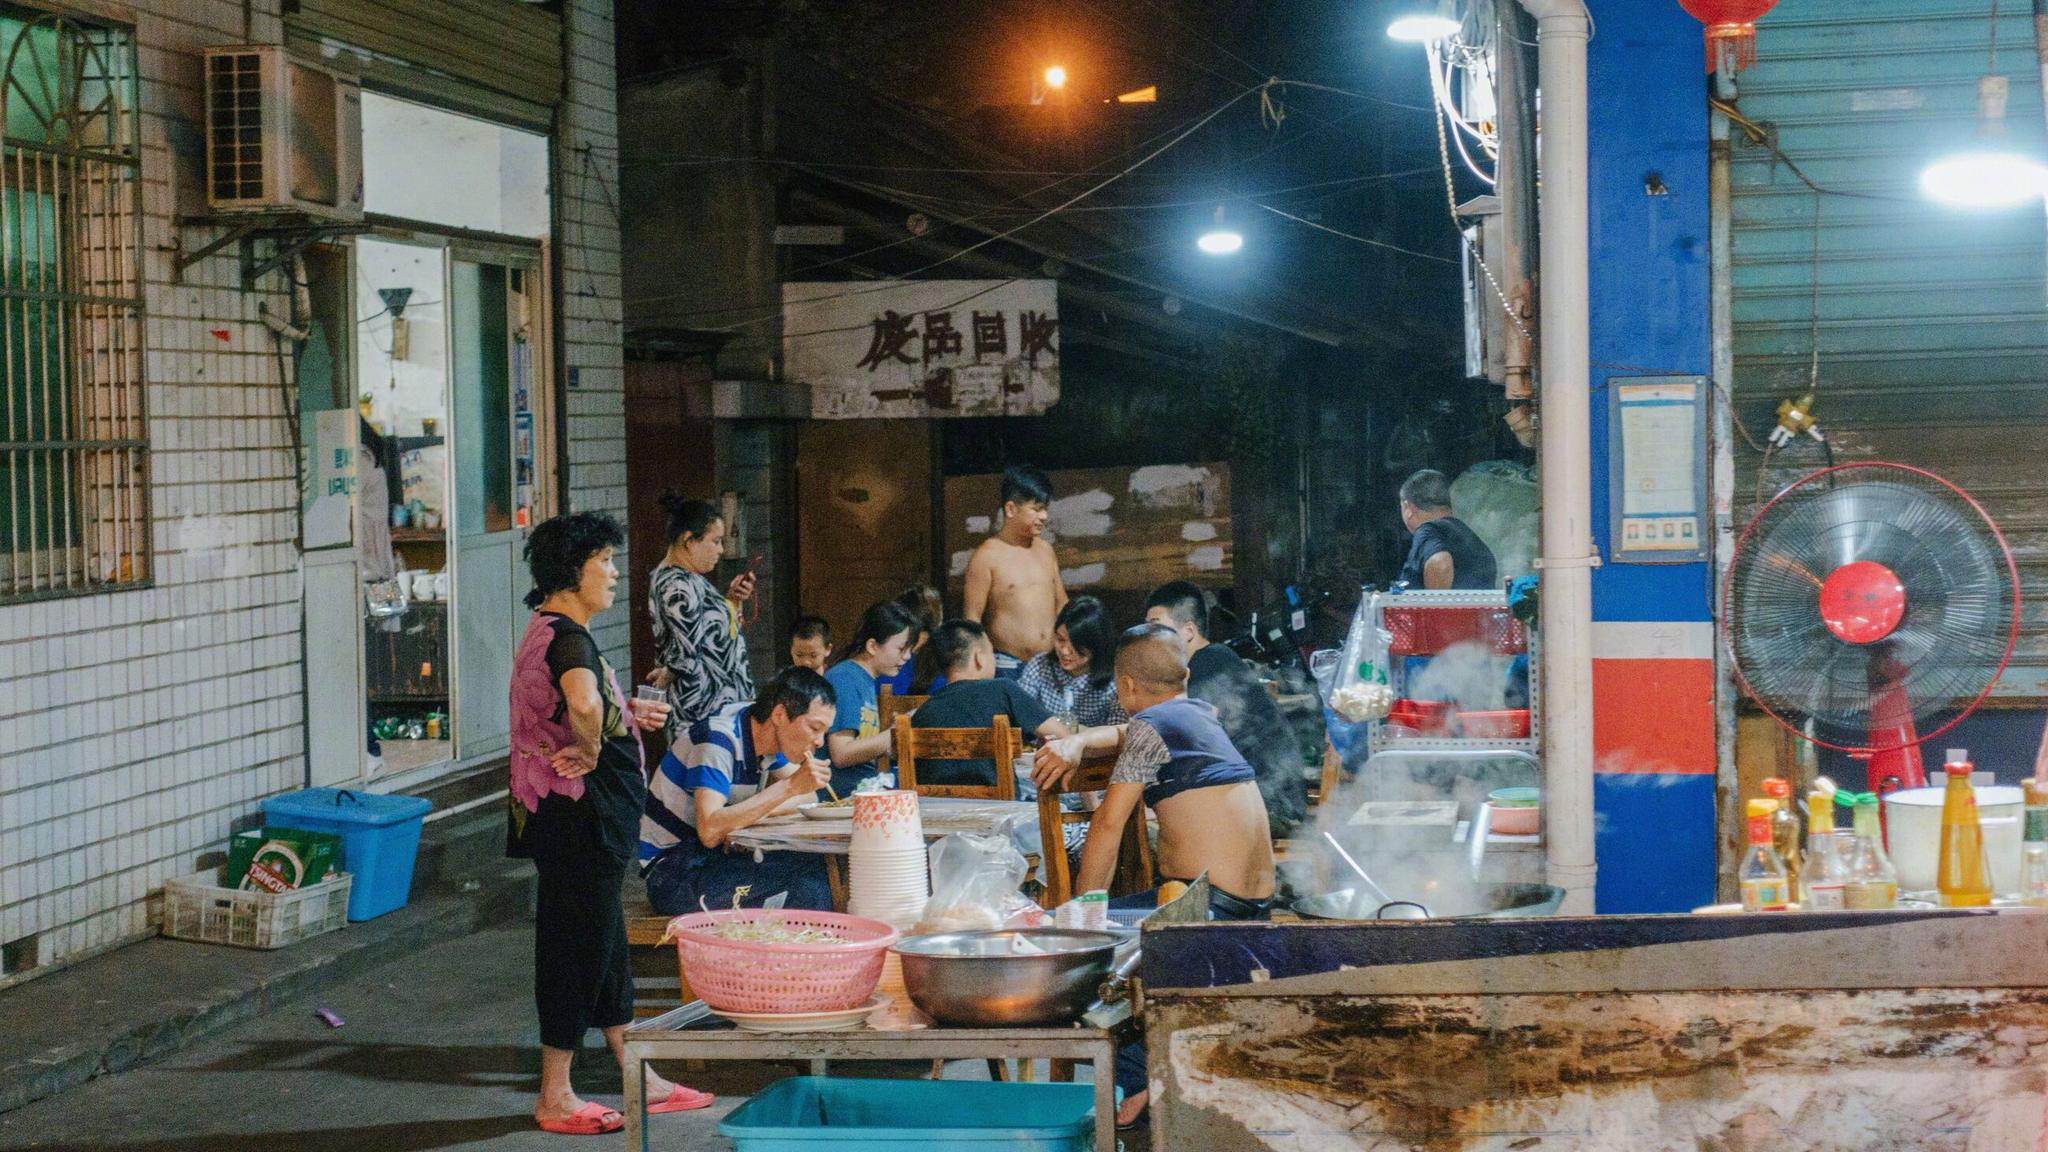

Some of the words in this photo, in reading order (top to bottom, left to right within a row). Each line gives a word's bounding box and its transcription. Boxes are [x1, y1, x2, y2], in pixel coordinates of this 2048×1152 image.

[856, 309, 1059, 372] 废品回收
[249, 863, 291, 893] TSINGTA
